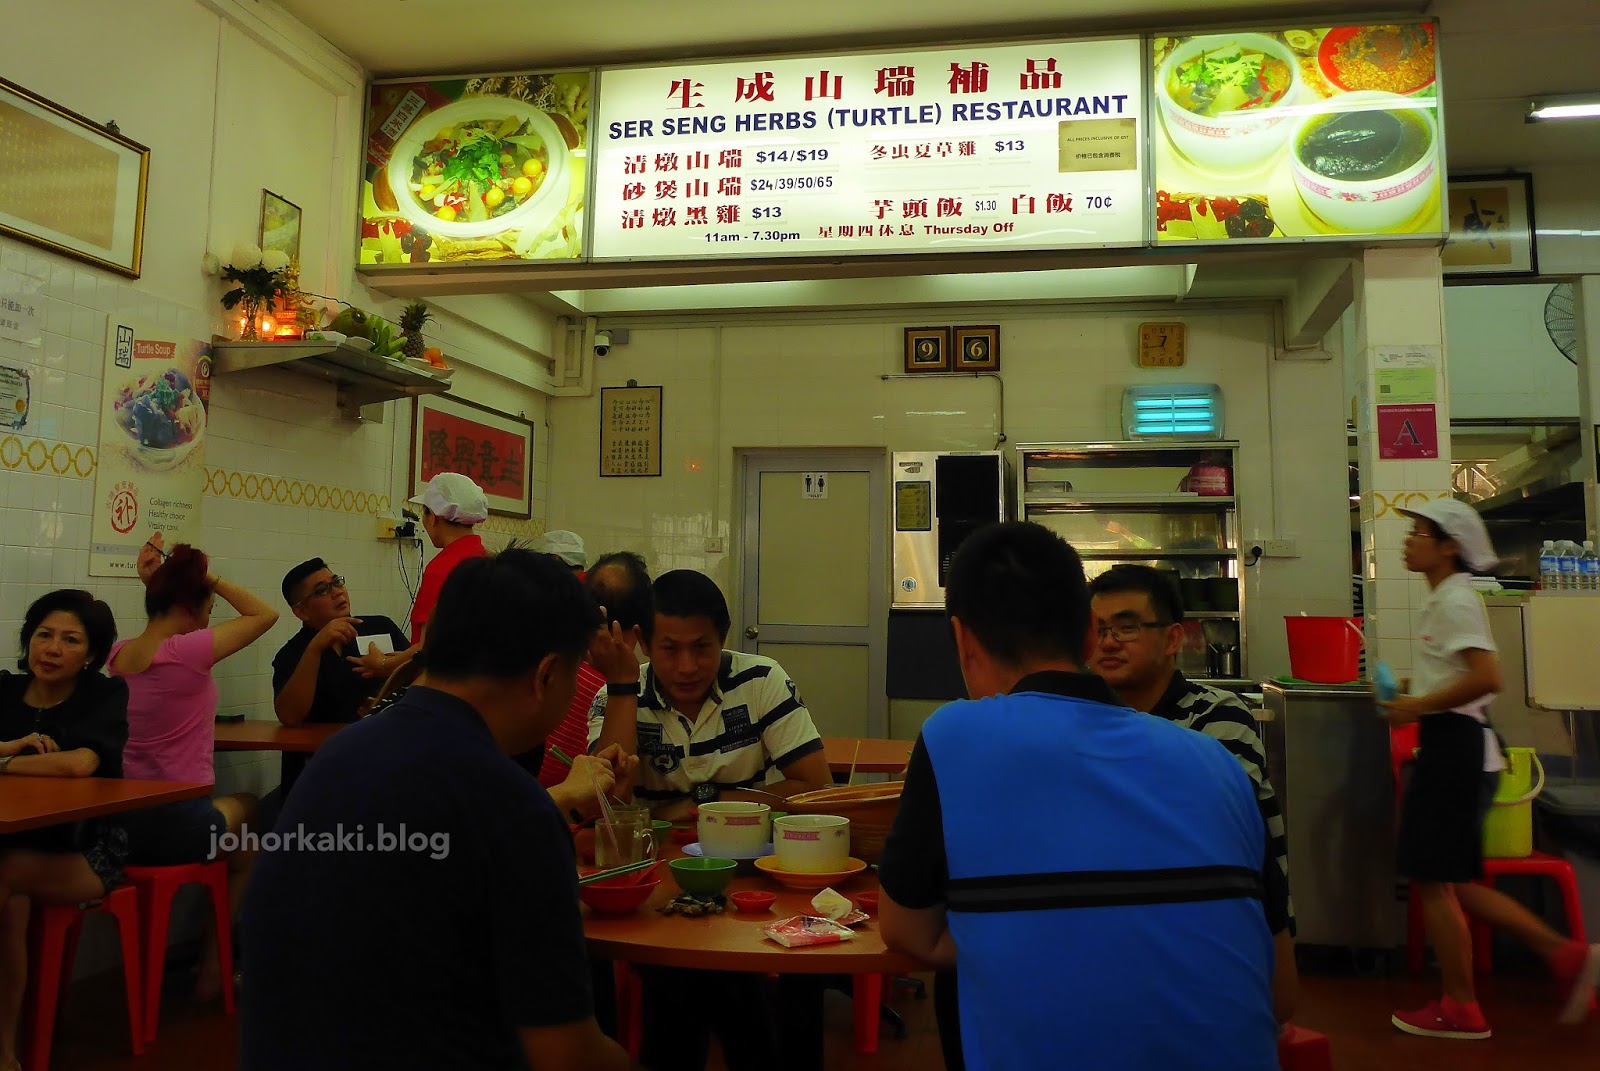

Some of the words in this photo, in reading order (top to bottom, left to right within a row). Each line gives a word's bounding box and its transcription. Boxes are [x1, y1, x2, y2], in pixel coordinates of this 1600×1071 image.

[666, 57, 1063, 109] 生成山瑞補品
[609, 120, 654, 140] SER
[661, 115, 726, 136] SENG
[735, 110, 817, 132] HERBS
[828, 103, 942, 129] (TURTLE)
[952, 95, 1128, 122] RESTAURANT
[870, 141, 977, 160] 冬虫夏草雞
[995, 140, 1025, 153] $13
[624, 149, 742, 175] 清燉山瑞
[756, 149, 829, 164] $14/$19
[622, 176, 742, 201] 砂煲山瑞
[750, 176, 833, 191] $24/39/50/65
[868, 196, 963, 220] 芋頭飯
[975, 201, 997, 212] $1.30
[1011, 192, 1073, 215] 白飯
[1086, 196, 1112, 209] 70¢
[621, 204, 742, 230] 清燉黑雞
[752, 206, 782, 220] $13
[705, 232, 741, 243] 11am
[752, 230, 801, 243] 7.30pm
[818, 223, 915, 238] 星期四休息
[924, 223, 988, 236] Thursday
[992, 222, 1014, 233] Off
[136, 343, 154, 355] Turtle
[154, 344, 171, 356] Soup
[921, 342, 933, 358] 9
[970, 341, 983, 357] 6
[1393, 418, 1423, 446] A
[149, 497, 171, 509] Collagen
[172, 500, 193, 510] richness
[148, 510, 168, 520] Healthy
[169, 513, 186, 521] choice
[148, 521, 165, 532] Vitality
[166, 524, 180, 532] tonic
